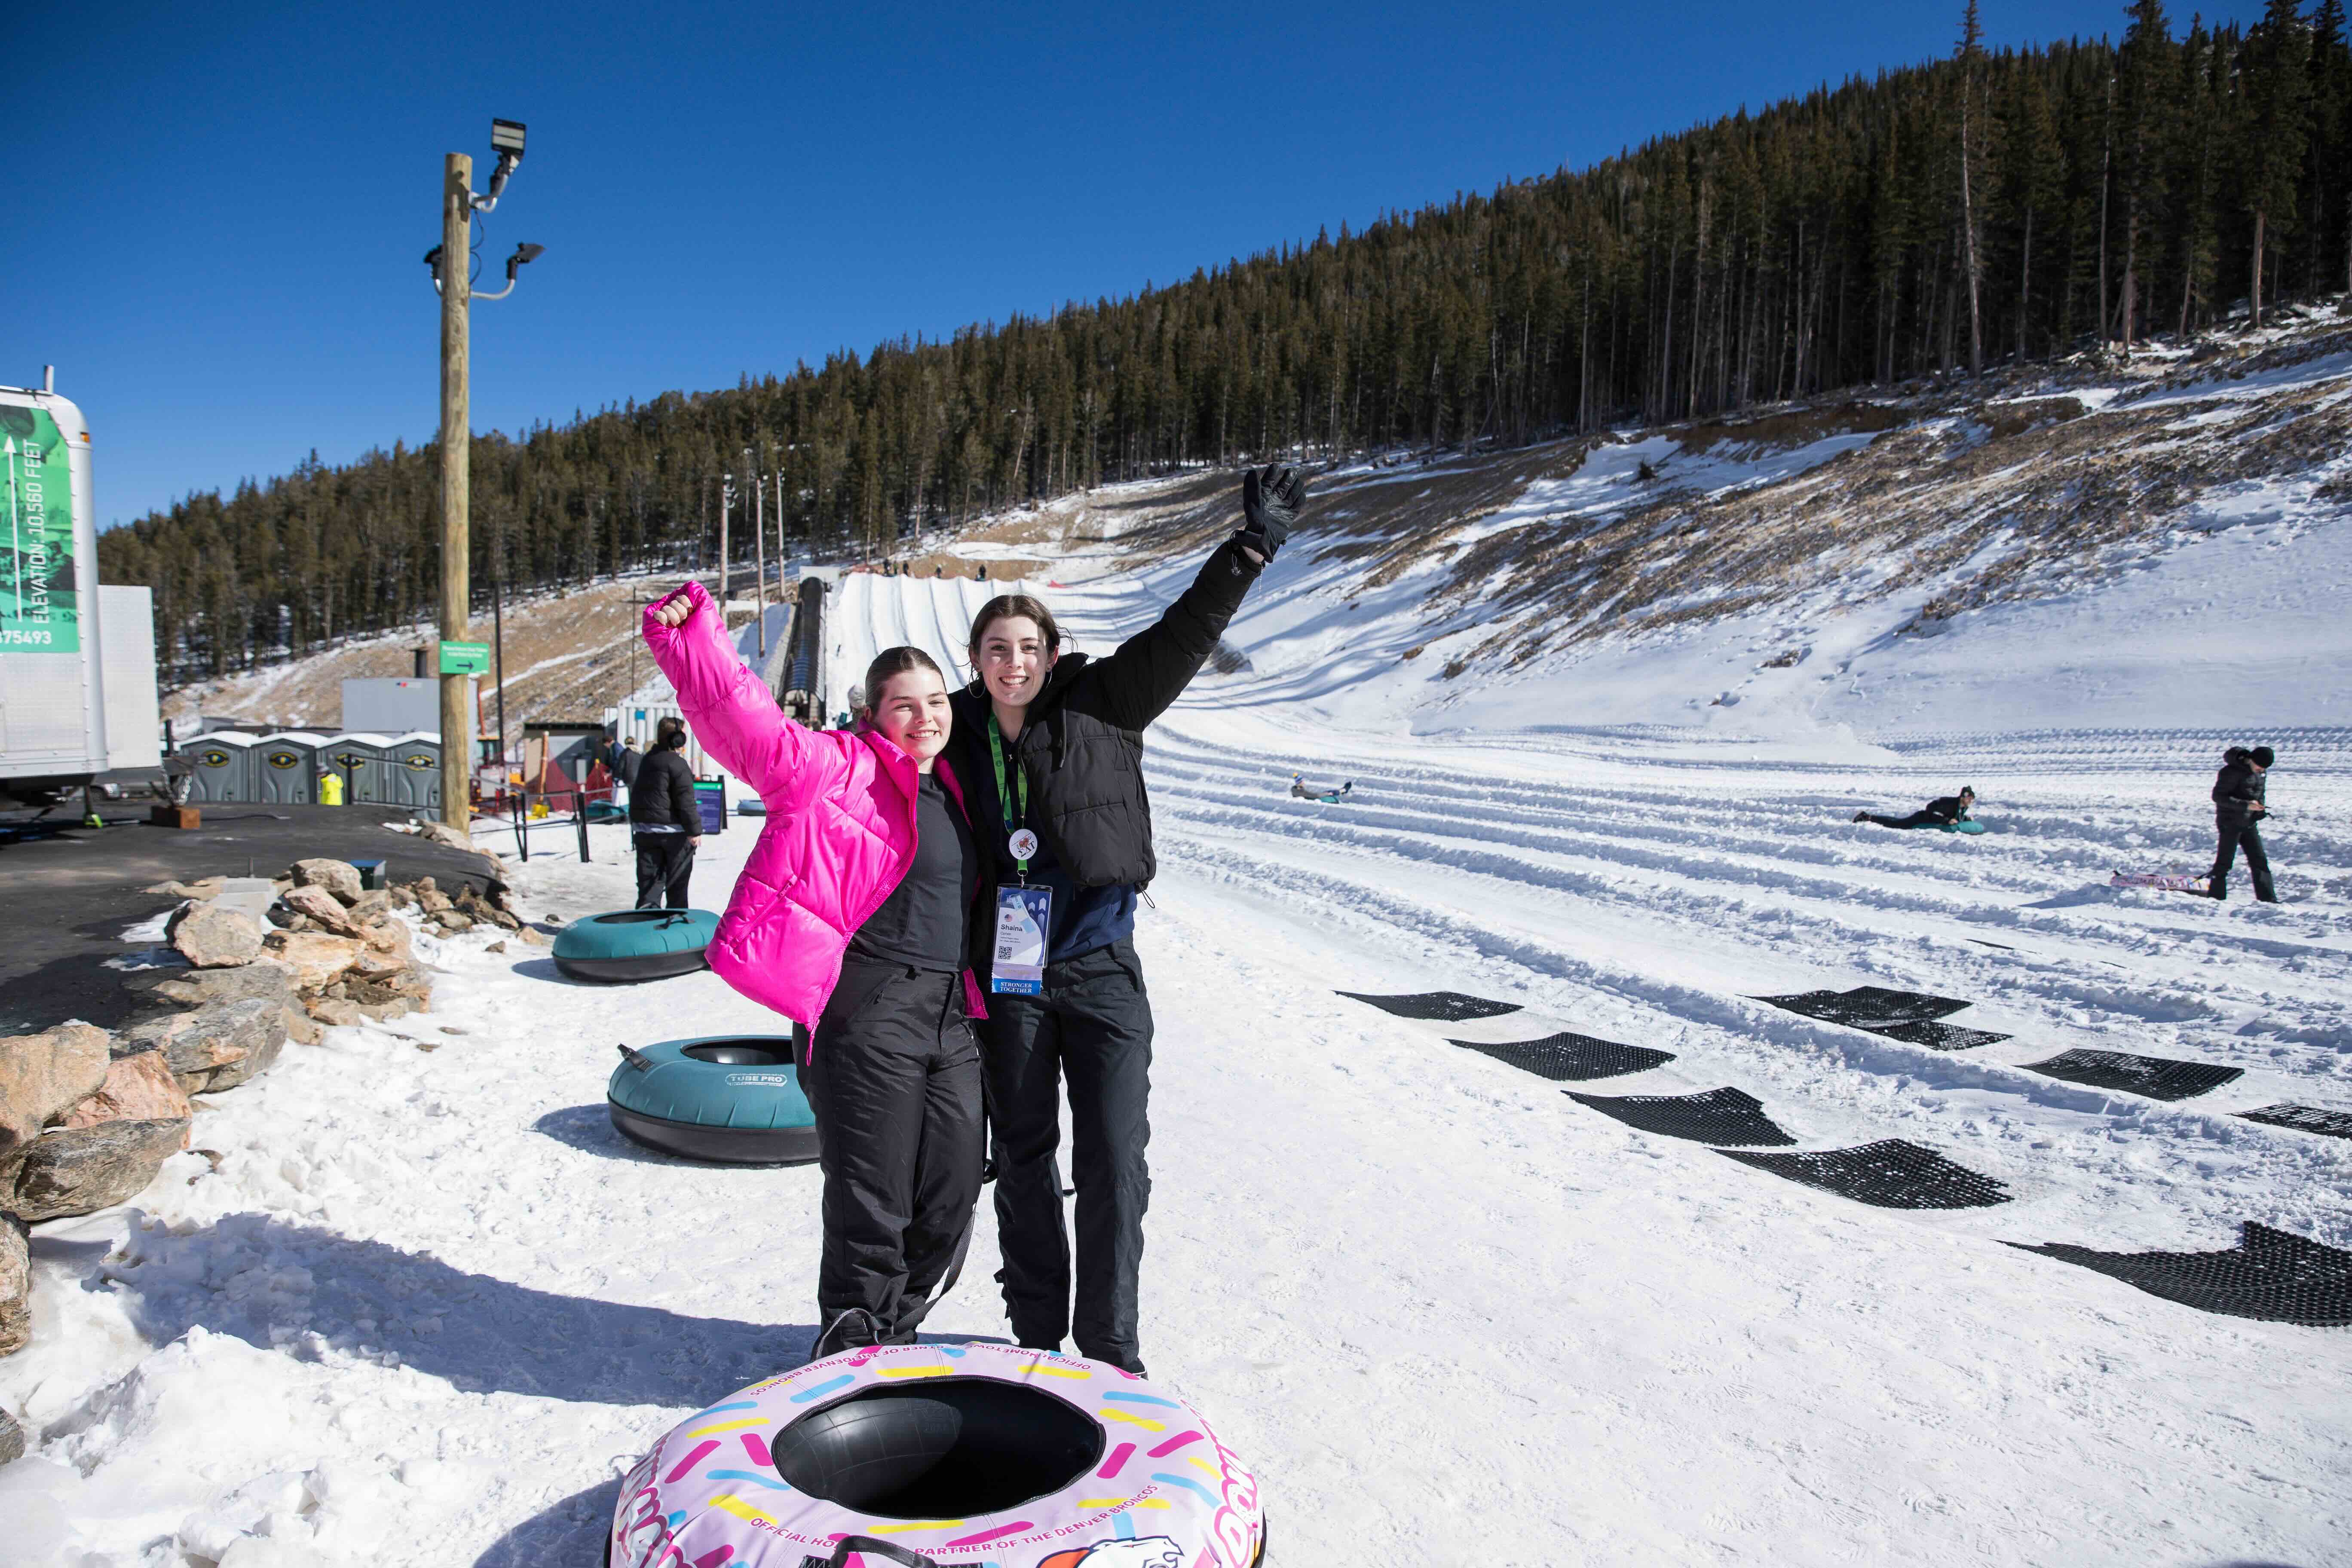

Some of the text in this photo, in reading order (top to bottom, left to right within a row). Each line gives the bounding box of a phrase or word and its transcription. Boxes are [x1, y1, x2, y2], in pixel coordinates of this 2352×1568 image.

[23, 438, 49, 624] ELEVATION: 10,560 FEET
[803, 1358, 851, 1372] DENVER
[853, 1352, 879, 1361] THE
[1042, 1353, 1091, 1370] OFFICIAL
[749, 1371, 803, 1396] BRONCOS
[750, 1518, 807, 1543] OFFICIAL
[915, 1544, 992, 1555] PARTNER
[997, 1538, 1017, 1549] OF
[1024, 1531, 1053, 1545] THE
[1055, 1512, 1110, 1537] DENVER
[1109, 1485, 1158, 1514] BRONCOS
